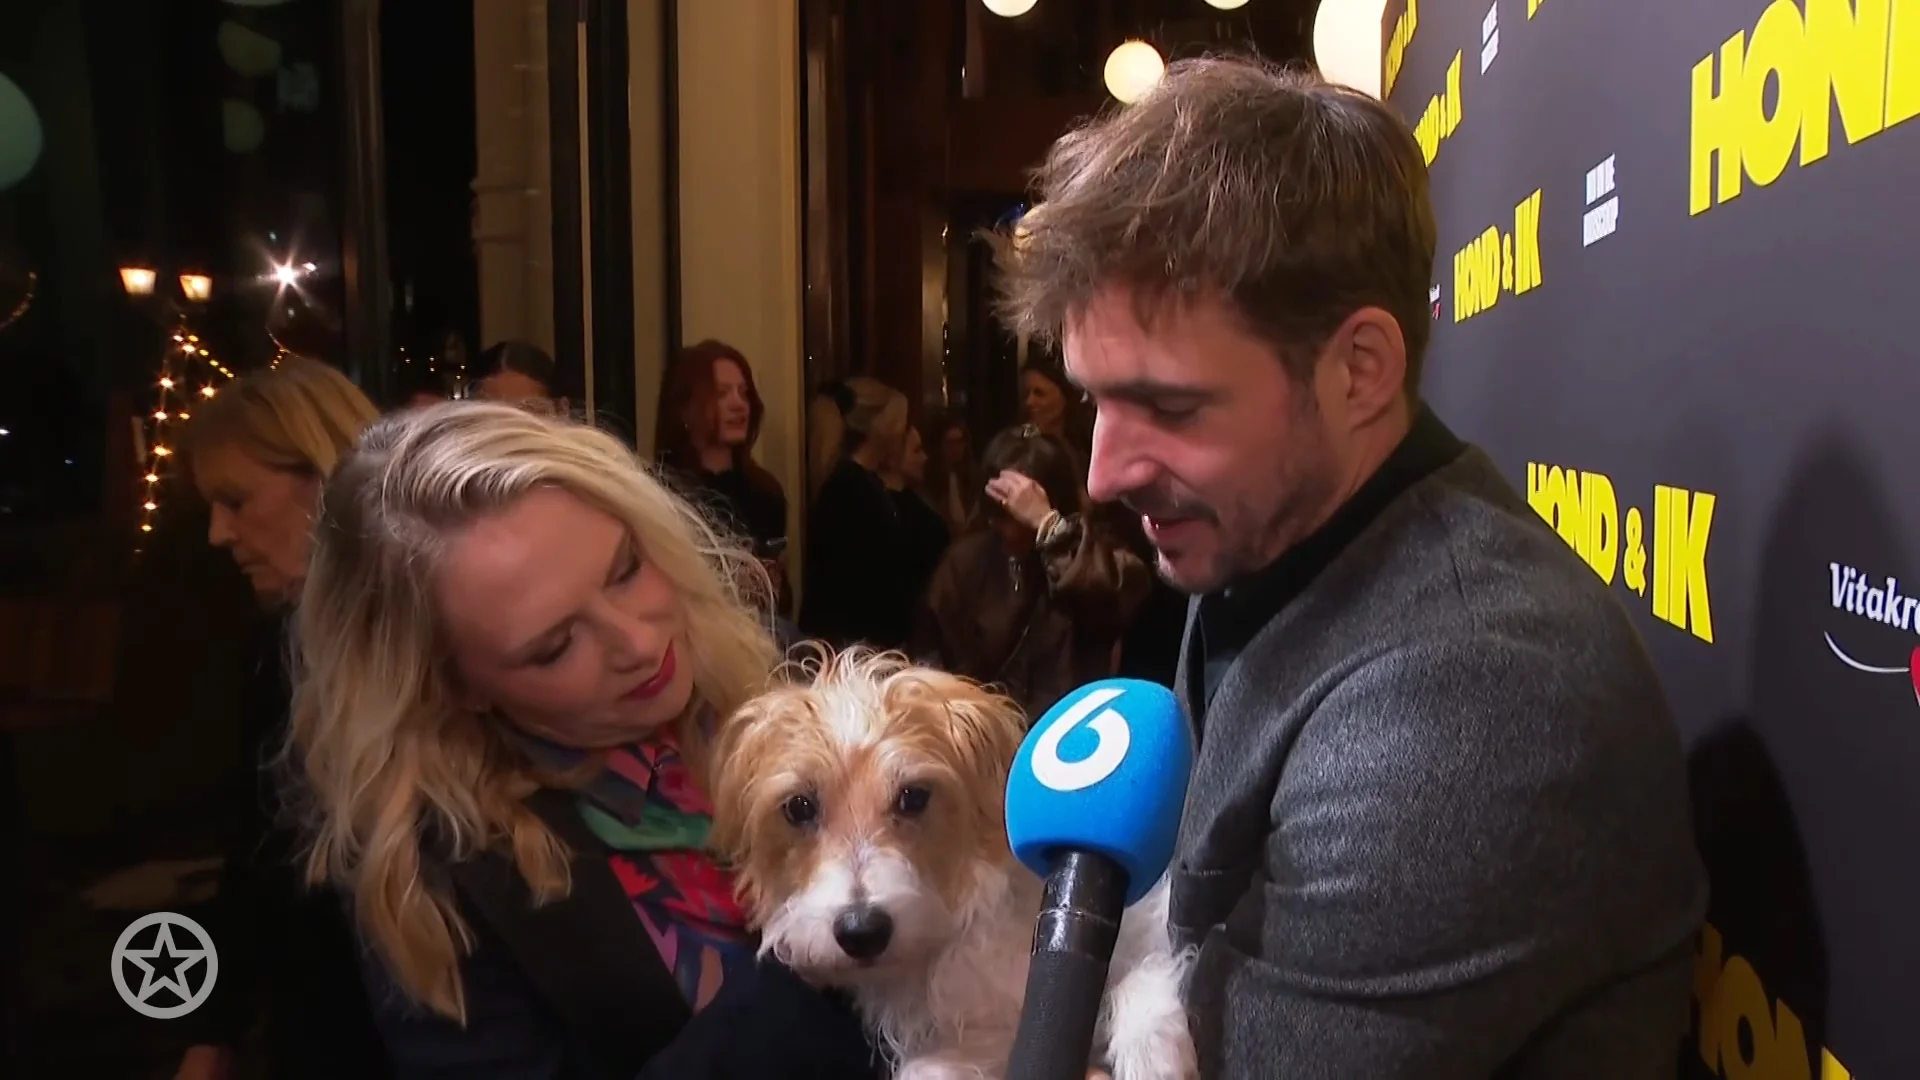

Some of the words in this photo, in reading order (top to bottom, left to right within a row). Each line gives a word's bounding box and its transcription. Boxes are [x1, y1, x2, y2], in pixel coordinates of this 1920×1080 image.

[1453, 224, 1501, 324] HOND
[1502, 231, 1513, 292] &
[1514, 187, 1543, 296] IK
[1623, 506, 1648, 599] &
[1652, 483, 1716, 644] IK
[1031, 687, 1131, 792] 6
